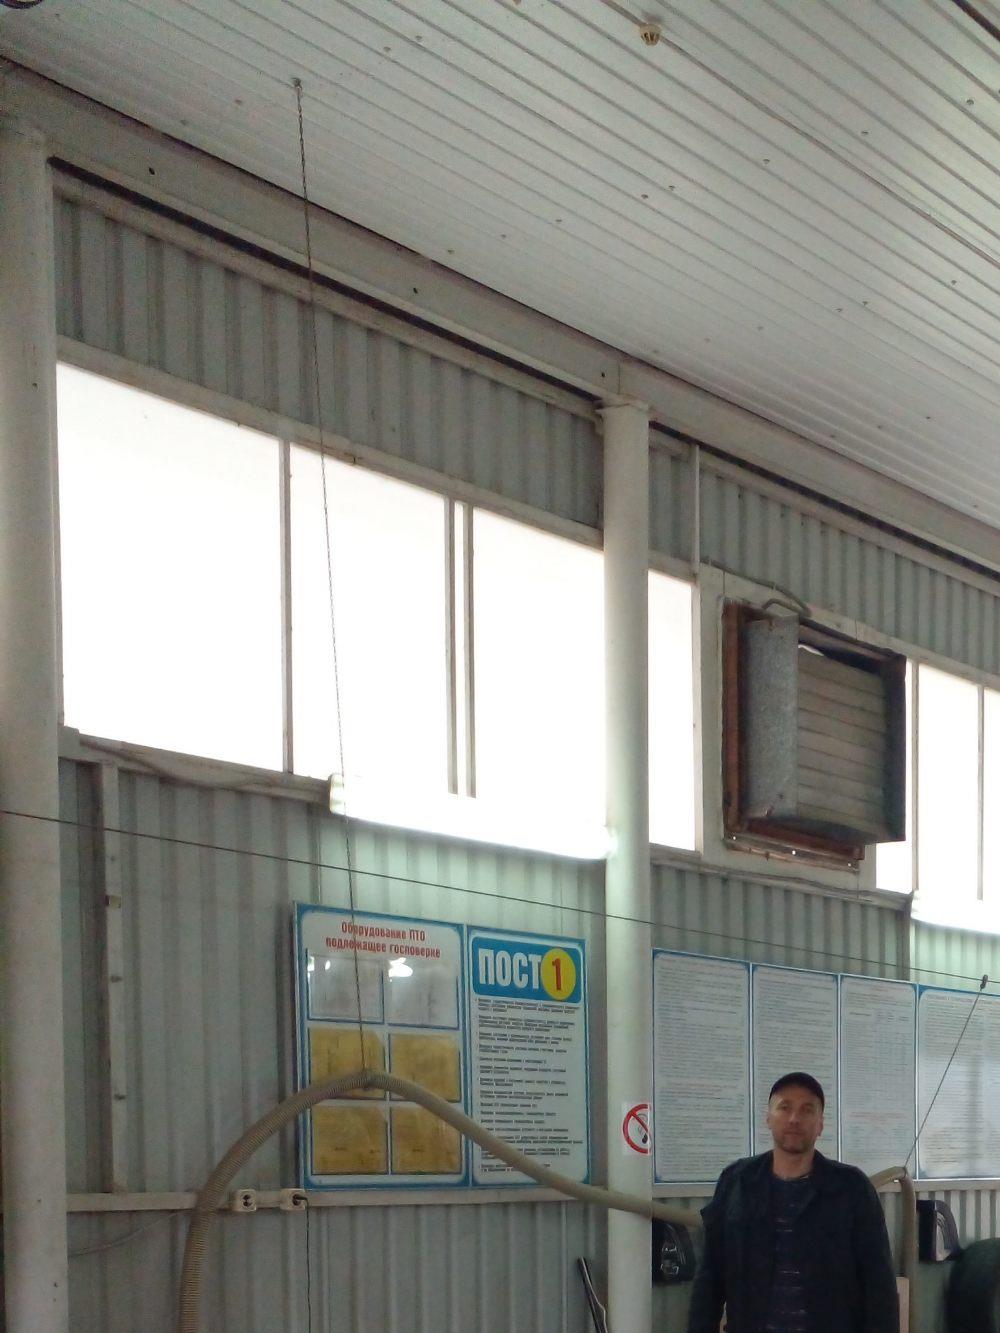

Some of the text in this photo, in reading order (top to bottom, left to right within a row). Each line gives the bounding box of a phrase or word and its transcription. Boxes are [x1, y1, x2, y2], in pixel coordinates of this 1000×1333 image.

[341, 921, 426, 942] Оборудование ПТО
[389, 944, 441, 959] госповерке
[478, 948, 542, 990] ПОСТ
[552, 958, 562, 991] 1
